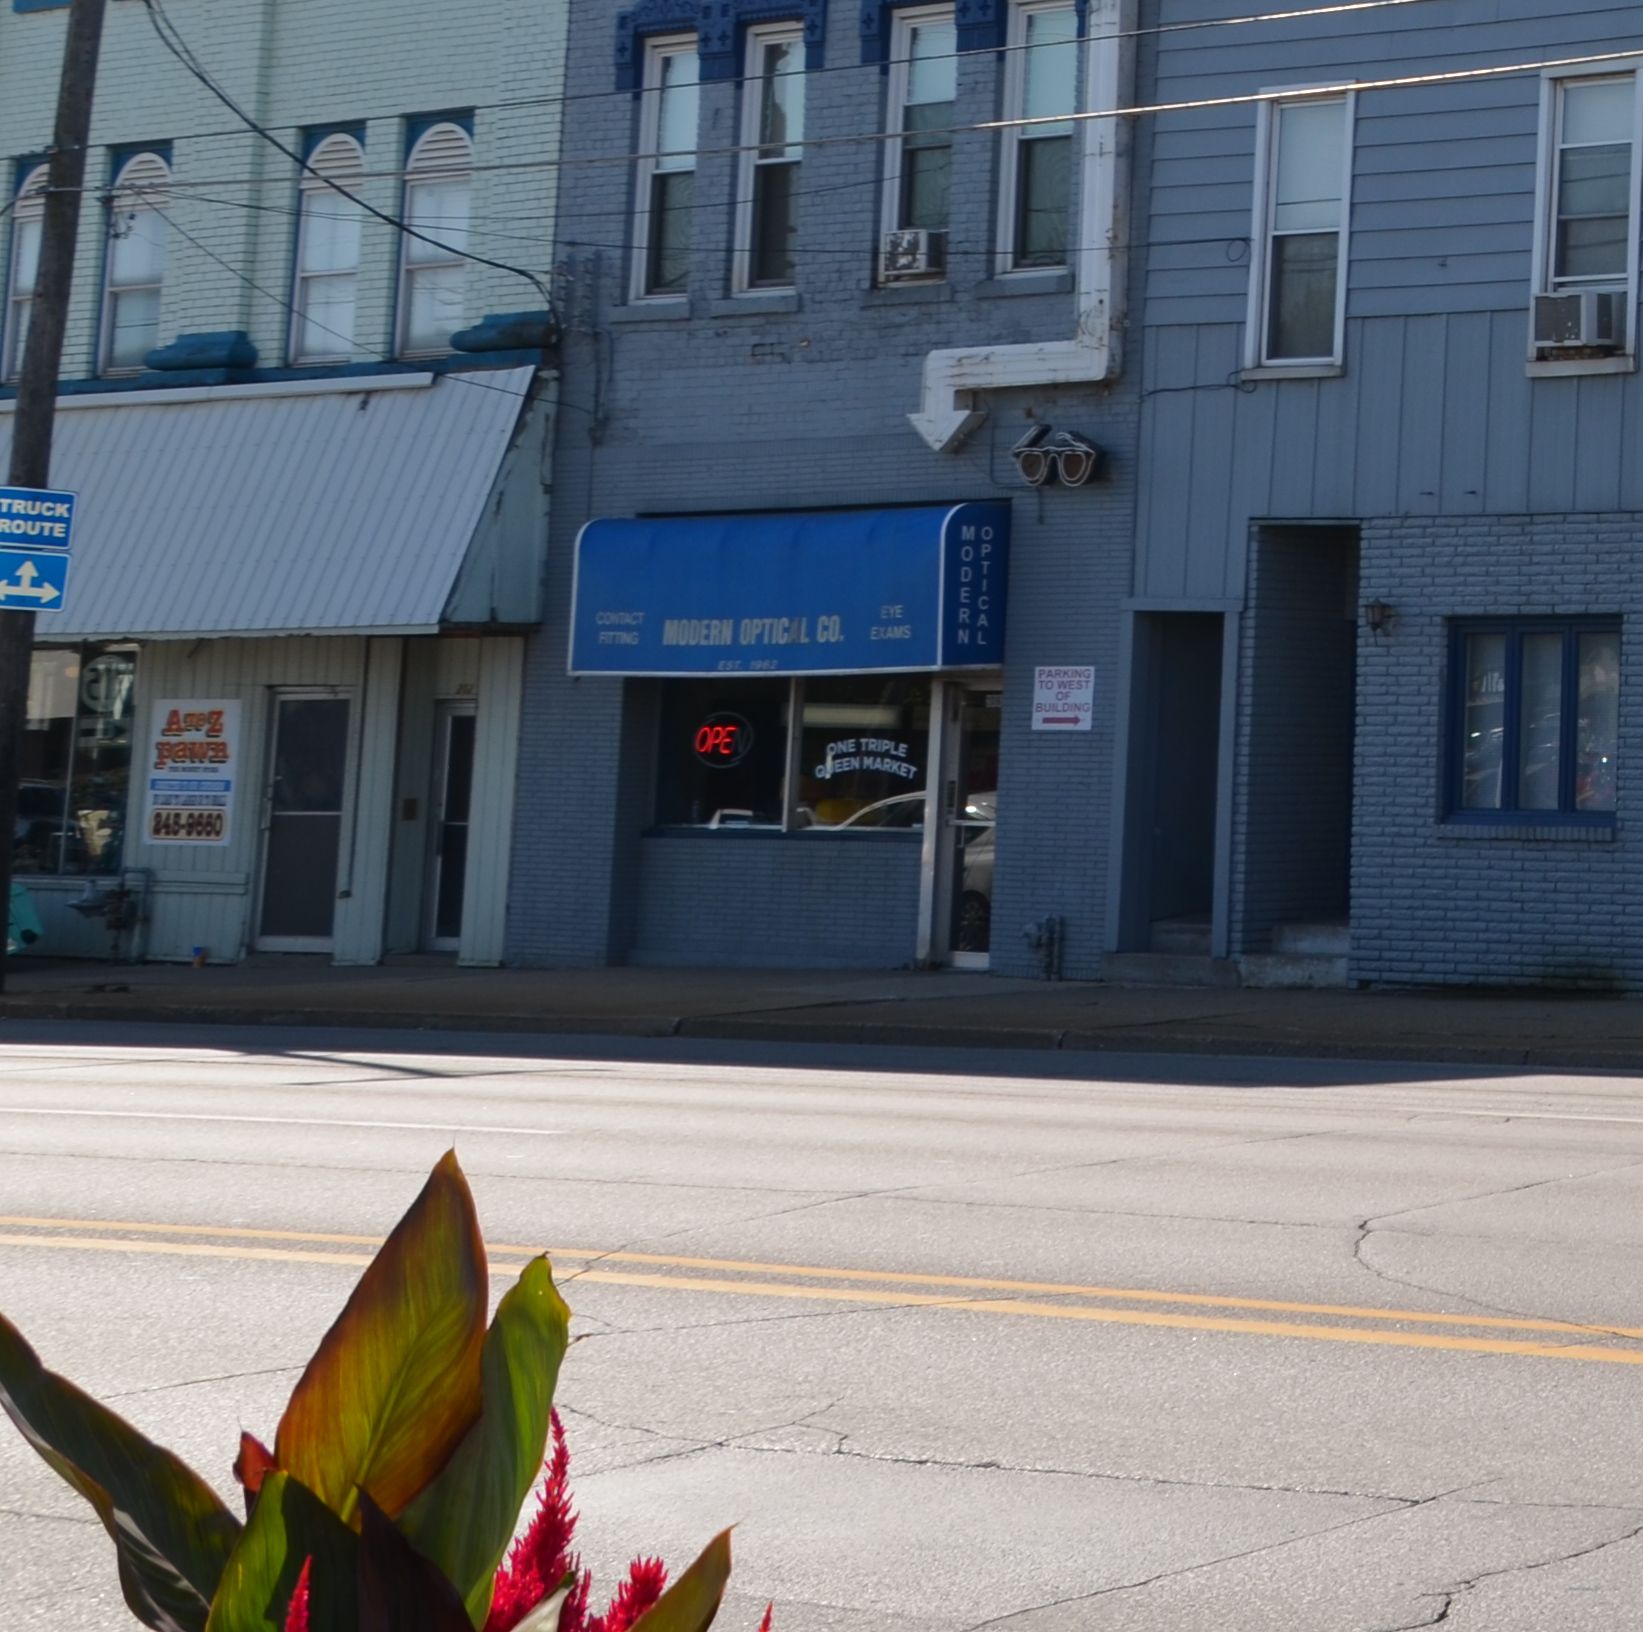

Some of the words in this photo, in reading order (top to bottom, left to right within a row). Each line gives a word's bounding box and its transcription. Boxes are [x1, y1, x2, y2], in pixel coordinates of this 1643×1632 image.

[0, 498, 70, 517] TRUCK
[0, 519, 67, 537] ROUTE
[958, 526, 975, 644] MODERN
[977, 527, 993, 645] OPTICAL
[596, 612, 645, 625] CONTACT
[881, 605, 904, 618] EYE
[599, 631, 639, 645] FITTING
[662, 619, 733, 646] MODERN
[740, 617, 809, 645] OPTICAL
[817, 615, 845, 643] CO.
[870, 625, 912, 640] EXAMS
[1038, 669, 1092, 679] PARKING
[1038, 679, 1054, 690] TO
[1057, 679, 1090, 690] WEST
[1055, 691, 1072, 701] OF
[1035, 702, 1090, 713] BUILDING
[162, 709, 185, 736] A
[206, 710, 224, 737] Z
[826, 739, 857, 756] ONE
[860, 738, 909, 757] TRIPLE
[863, 756, 918, 779] MARKET
